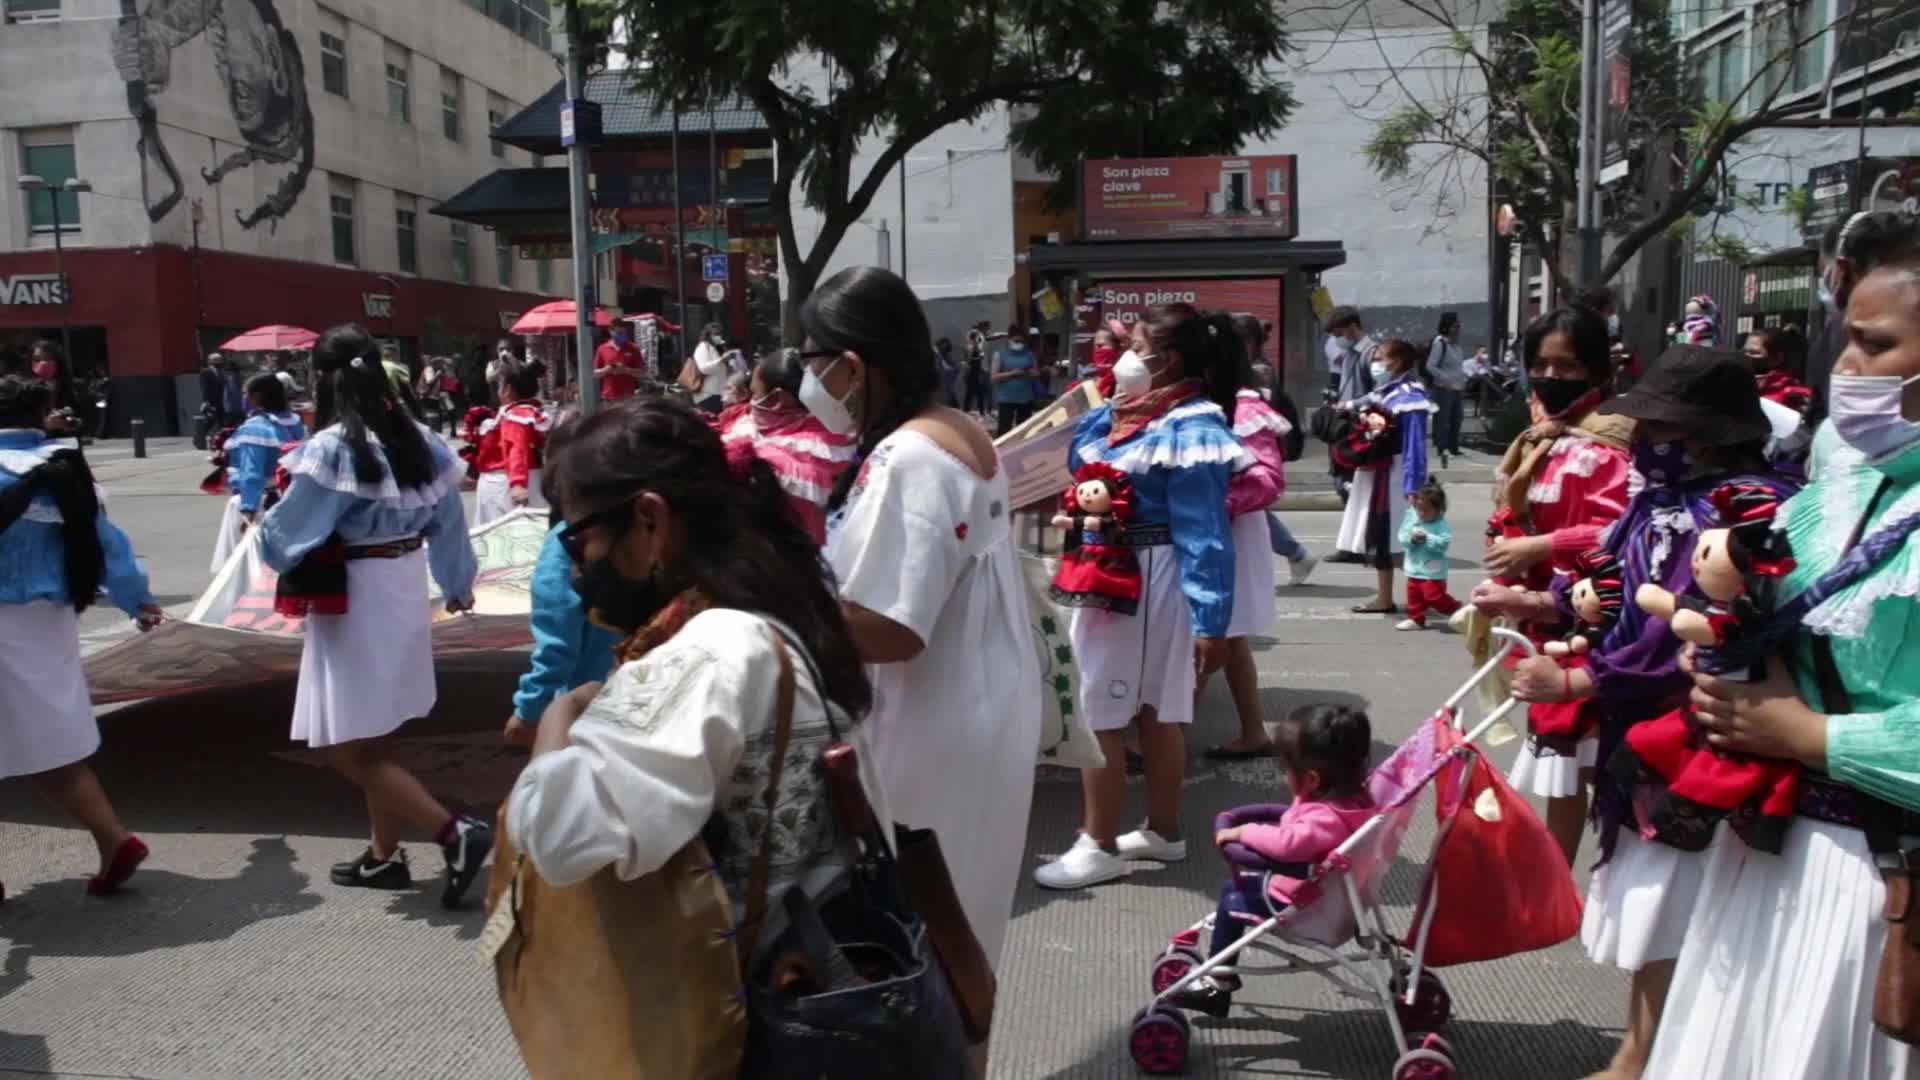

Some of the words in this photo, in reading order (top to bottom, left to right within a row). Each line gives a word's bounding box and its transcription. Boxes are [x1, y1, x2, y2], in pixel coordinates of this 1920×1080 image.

[1103, 166, 1129, 178] Son
[1132, 165, 1170, 179] pieza
[1103, 180, 1141, 192] clave
[0, 274, 67, 305] VANS
[1104, 289, 1140, 305] Son
[1144, 288, 1196, 306] pieza
